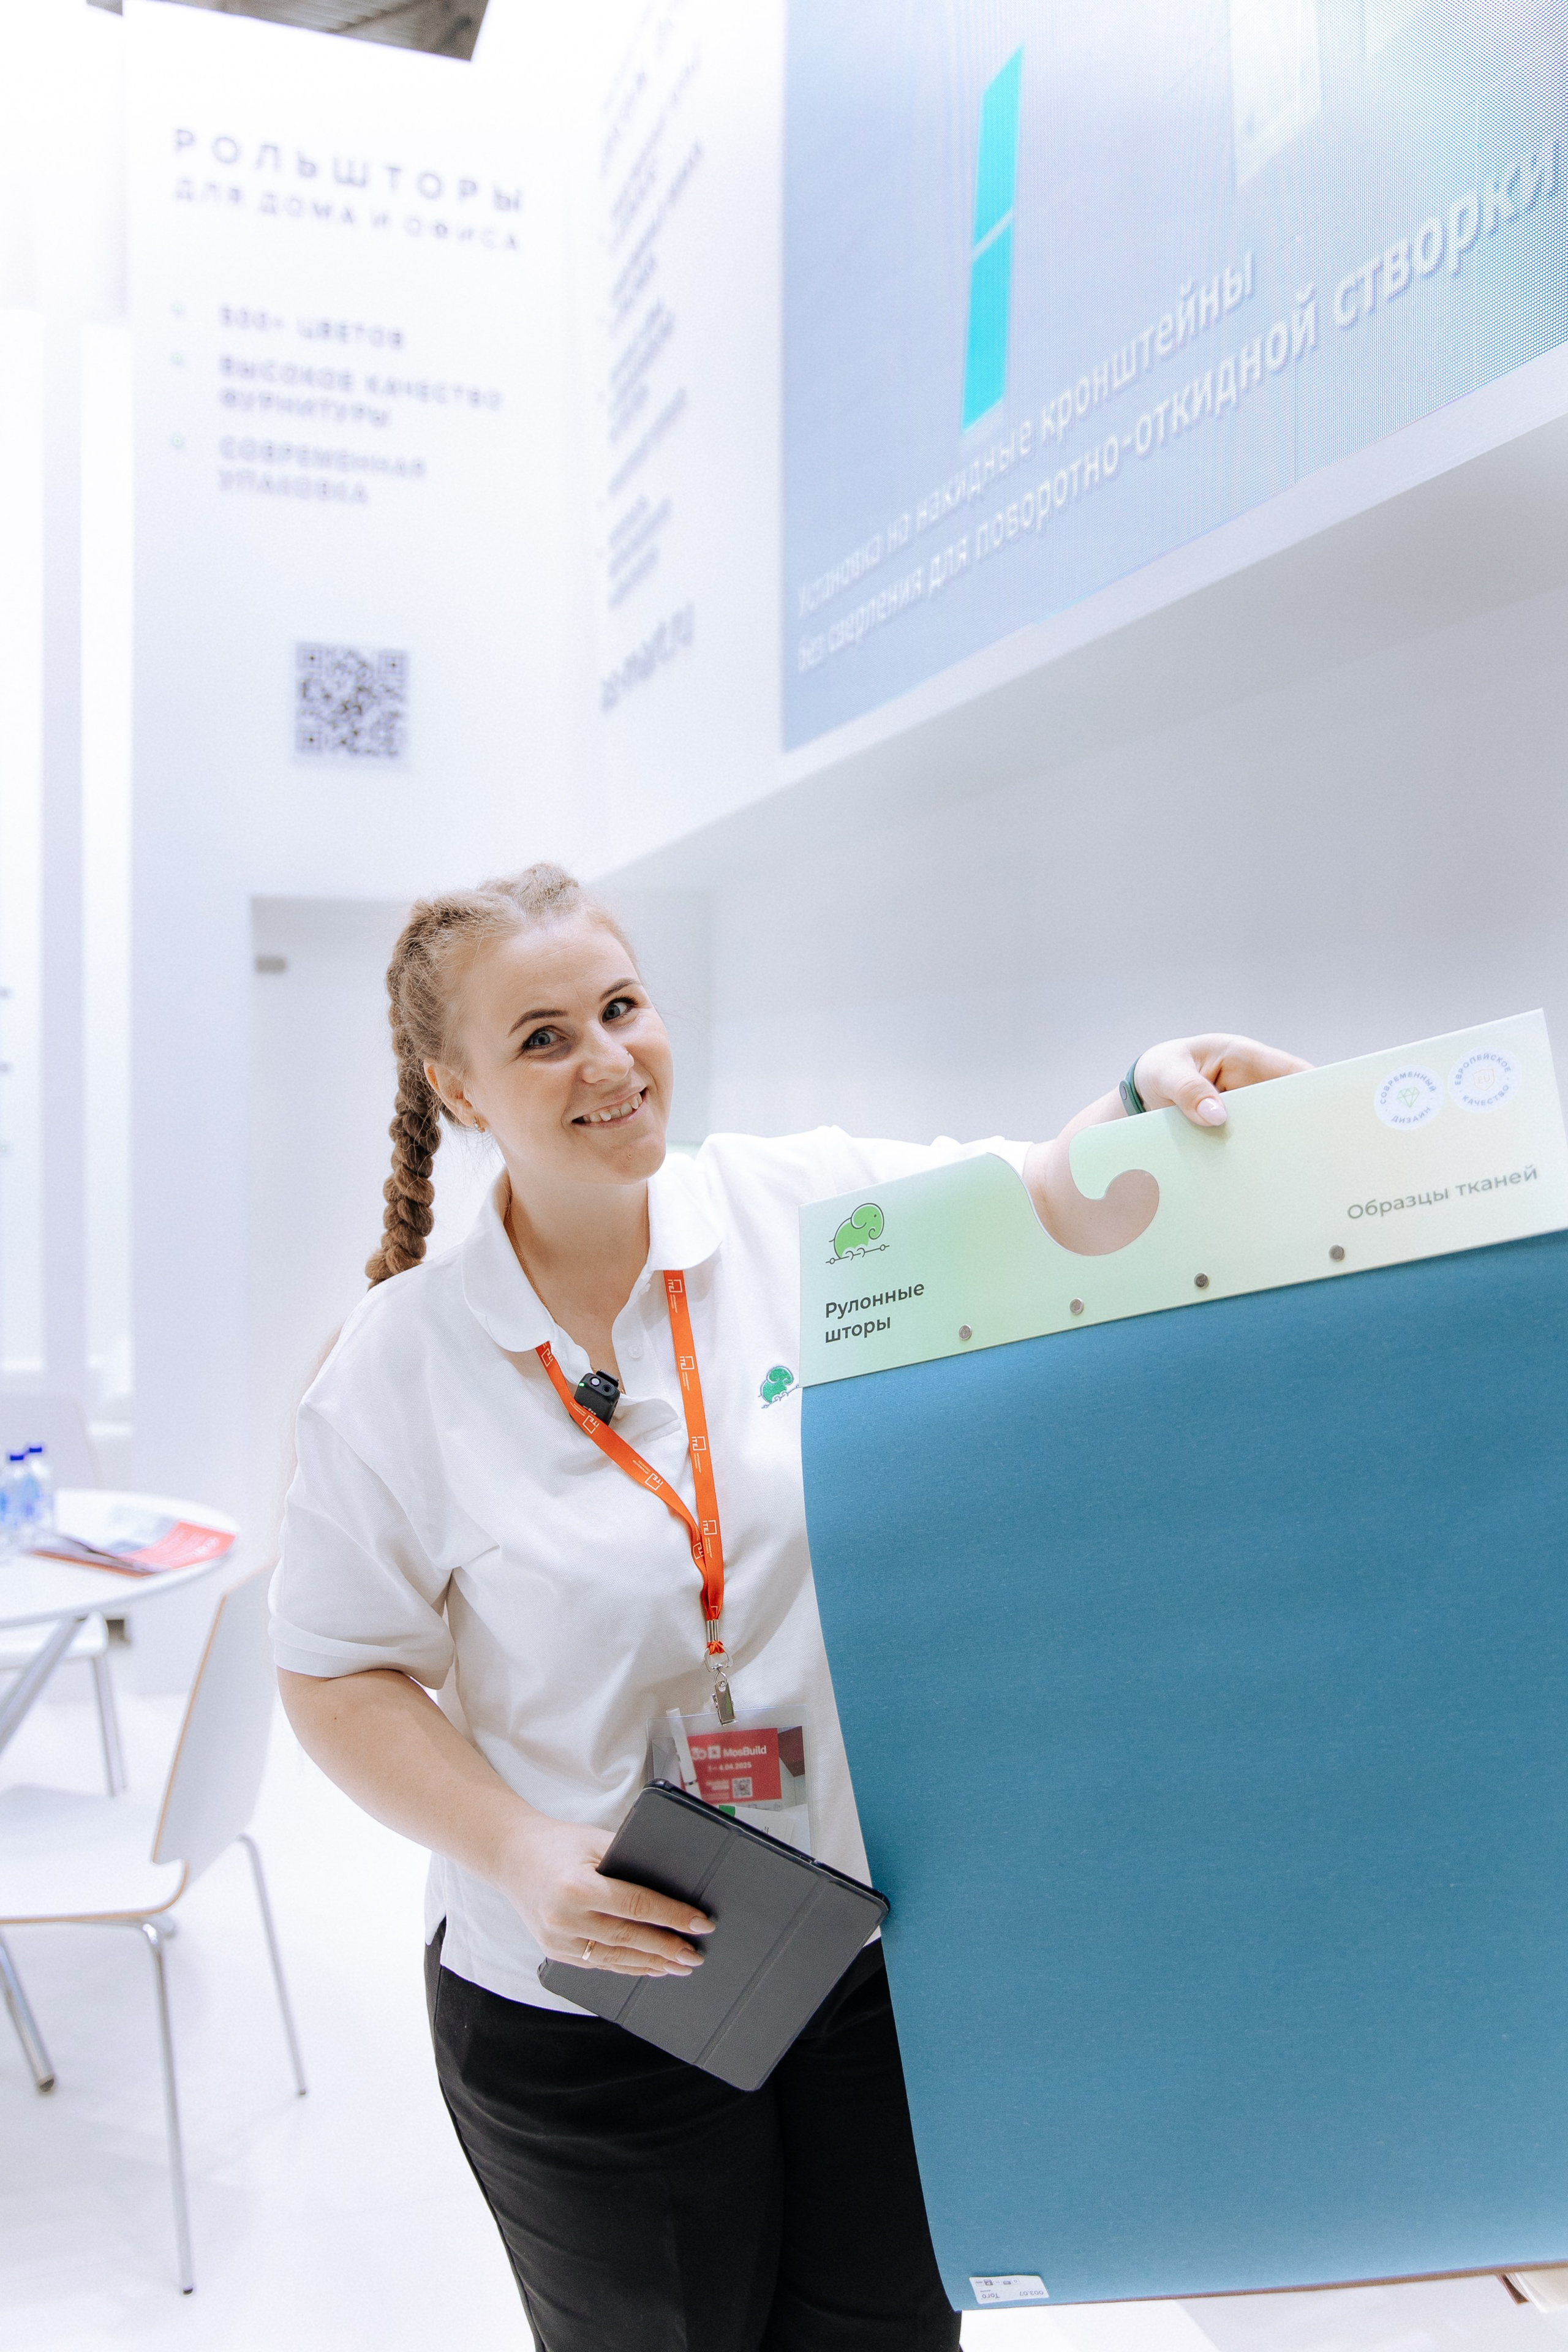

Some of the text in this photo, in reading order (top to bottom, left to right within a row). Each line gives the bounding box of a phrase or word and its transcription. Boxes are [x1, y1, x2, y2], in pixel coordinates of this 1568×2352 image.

[175, 127, 522, 213] РОЛЬШТОРЫ
[175, 178, 519, 251] ДЛЯ ДОМА И ОФИСА
[297, 316, 405, 351] ЦВЕТОВ
[219, 352, 353, 393] ВЫСОКОЕ
[928, 535, 970, 598] для
[975, 283, 1319, 559] поворотно-откидной
[1334, 136, 1558, 330] створки
[916, 420, 1035, 532] накидные
[1041, 250, 1254, 445] кронштейны
[1455, 1052, 1512, 1086] ЕВРОПЕЙСКОЕ
[1379, 1071, 1437, 1105] СОВРЕМЕННЫЙ
[1462, 1084, 1510, 1106] КАЧЕСТВО
[1391, 1106, 1431, 1124] ДИЗАЙН
[1347, 1164, 1539, 1219] Образцы тканей
[825, 1282, 925, 1320] Рулонные
[825, 1316, 891, 1343] шторы
[723, 1745, 767, 1757] MosBuild
